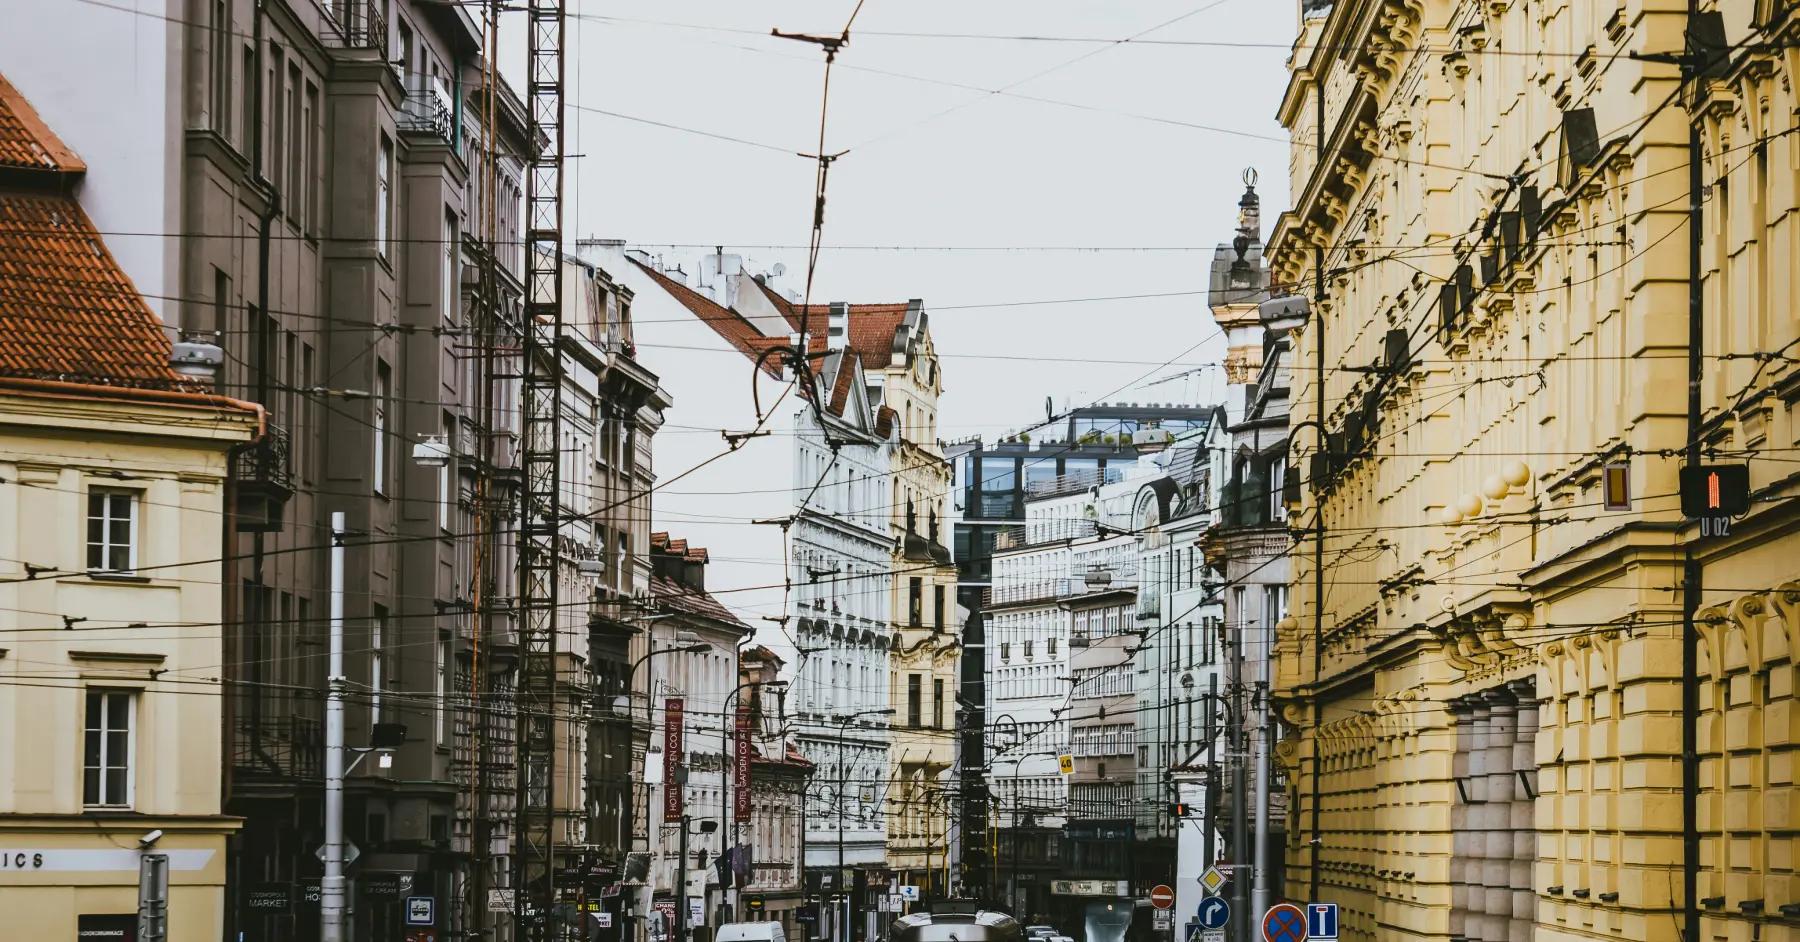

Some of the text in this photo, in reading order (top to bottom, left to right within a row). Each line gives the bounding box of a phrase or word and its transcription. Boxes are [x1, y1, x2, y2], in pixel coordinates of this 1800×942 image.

[1701, 517, 1730, 536] U 02
[1061, 759, 1072, 769] 40
[669, 787, 678, 811] HOTEL
[3, 853, 43, 868] ICS
[248, 899, 288, 908] MARKET
